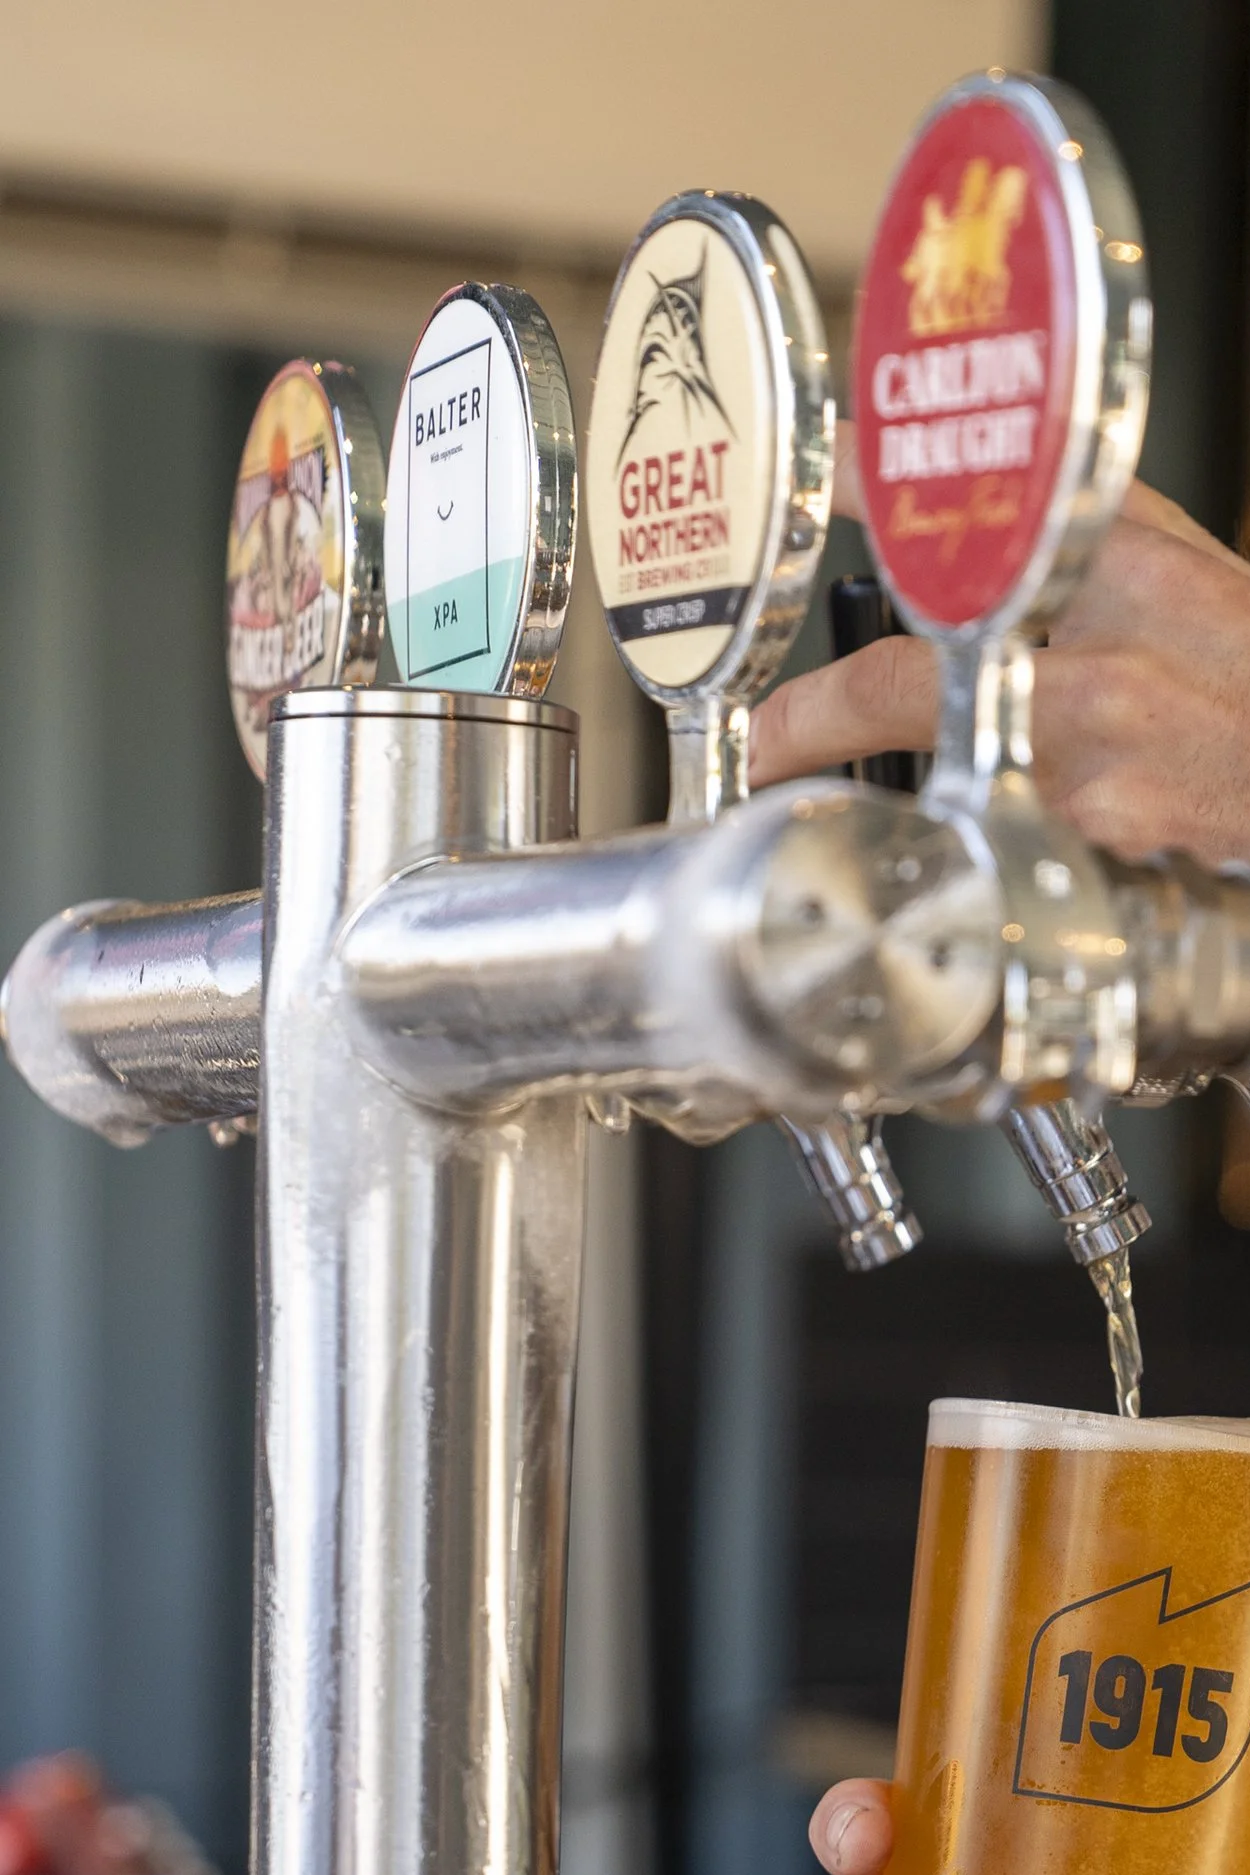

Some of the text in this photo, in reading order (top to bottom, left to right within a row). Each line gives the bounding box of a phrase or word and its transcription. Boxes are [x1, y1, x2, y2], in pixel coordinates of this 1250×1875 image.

[415, 386, 481, 447] BALTER
[619, 440, 728, 519] GREAT
[618, 505, 729, 568] NORTHERN
[434, 598, 458, 631] XPA
[1058, 1650, 1234, 1763] 1915
